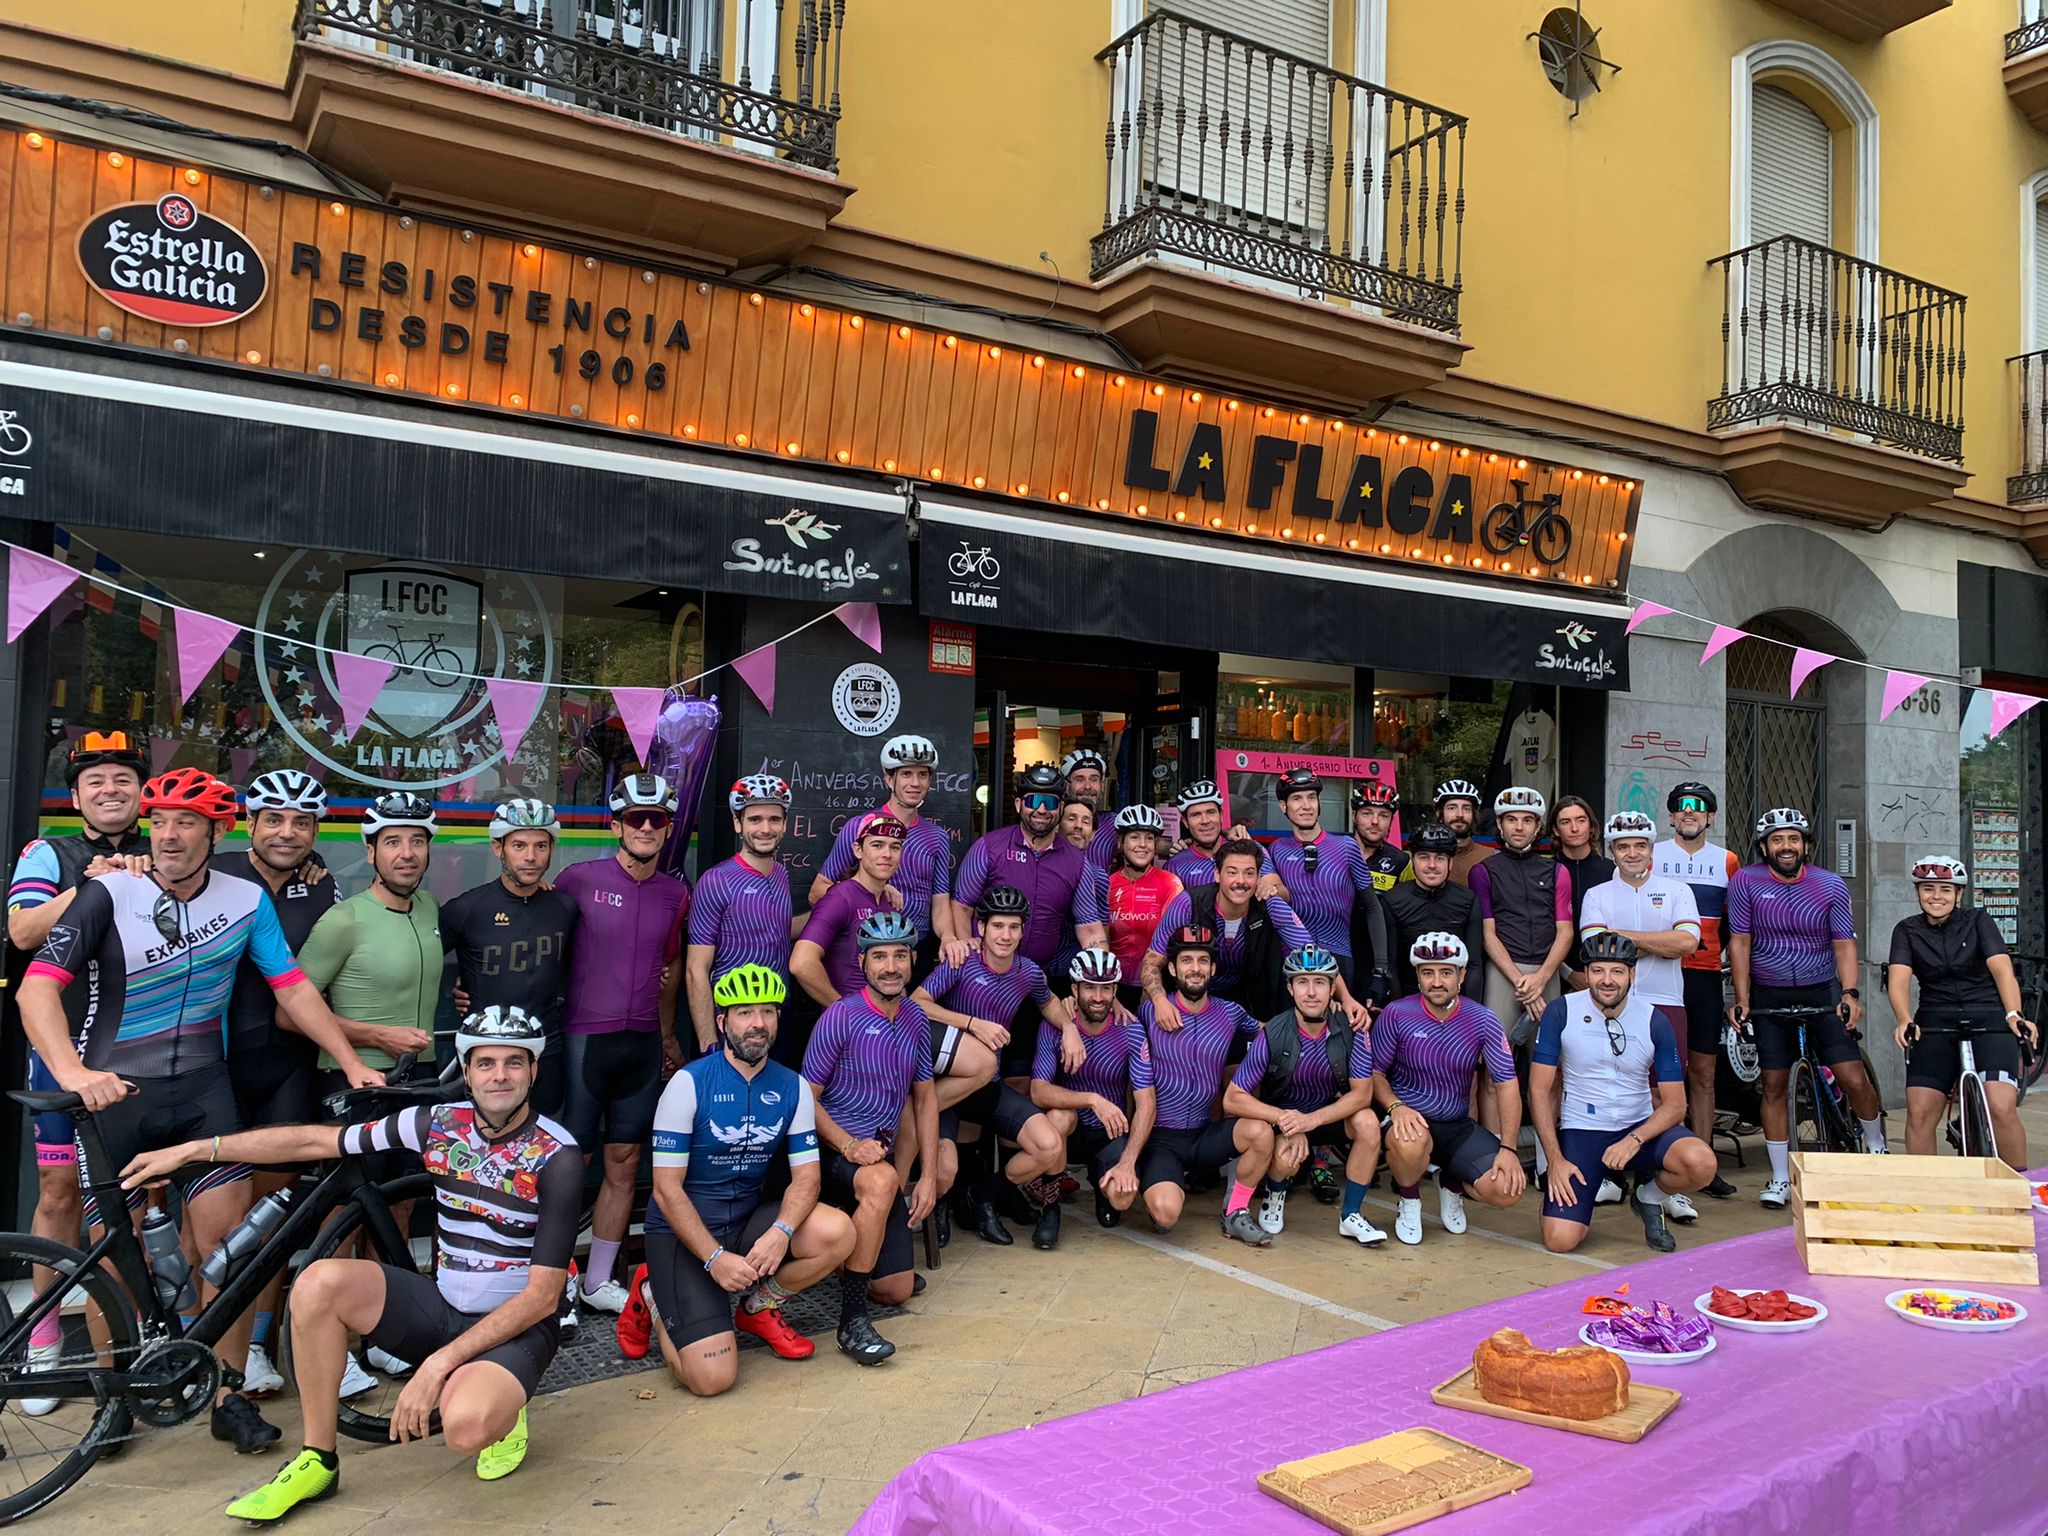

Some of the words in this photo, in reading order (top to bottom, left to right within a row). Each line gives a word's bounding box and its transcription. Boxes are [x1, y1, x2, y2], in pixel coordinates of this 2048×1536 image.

[104, 219, 246, 275] Estrella
[111, 254, 237, 306] Galicia
[291, 241, 691, 351] RESISTENCIA
[311, 298, 510, 364] DESDE
[548, 343, 666, 391] 1906
[1124, 409, 1225, 502] LA
[1247, 434, 1474, 544] FLACA
[382, 579, 448, 616] LFCC
[951, 590, 965, 605] LA
[966, 592, 998, 609] FLACA
[934, 626, 972, 639] Alarma
[857, 680, 875, 691] LFCC
[357, 745, 384, 766] LA
[391, 746, 458, 768] FLACA
[790, 760, 886, 791] ANIVERSA
[793, 815, 818, 838] EL
[878, 825, 901, 837] LFCC
[1006, 849, 1027, 863] LFCC
[1663, 862, 1715, 876] GOBIK
[287, 883, 308, 899] ES
[594, 889, 623, 908] LFCC
[857, 908, 873, 920] LFCC
[144, 913, 229, 963] EXPOBIKES
